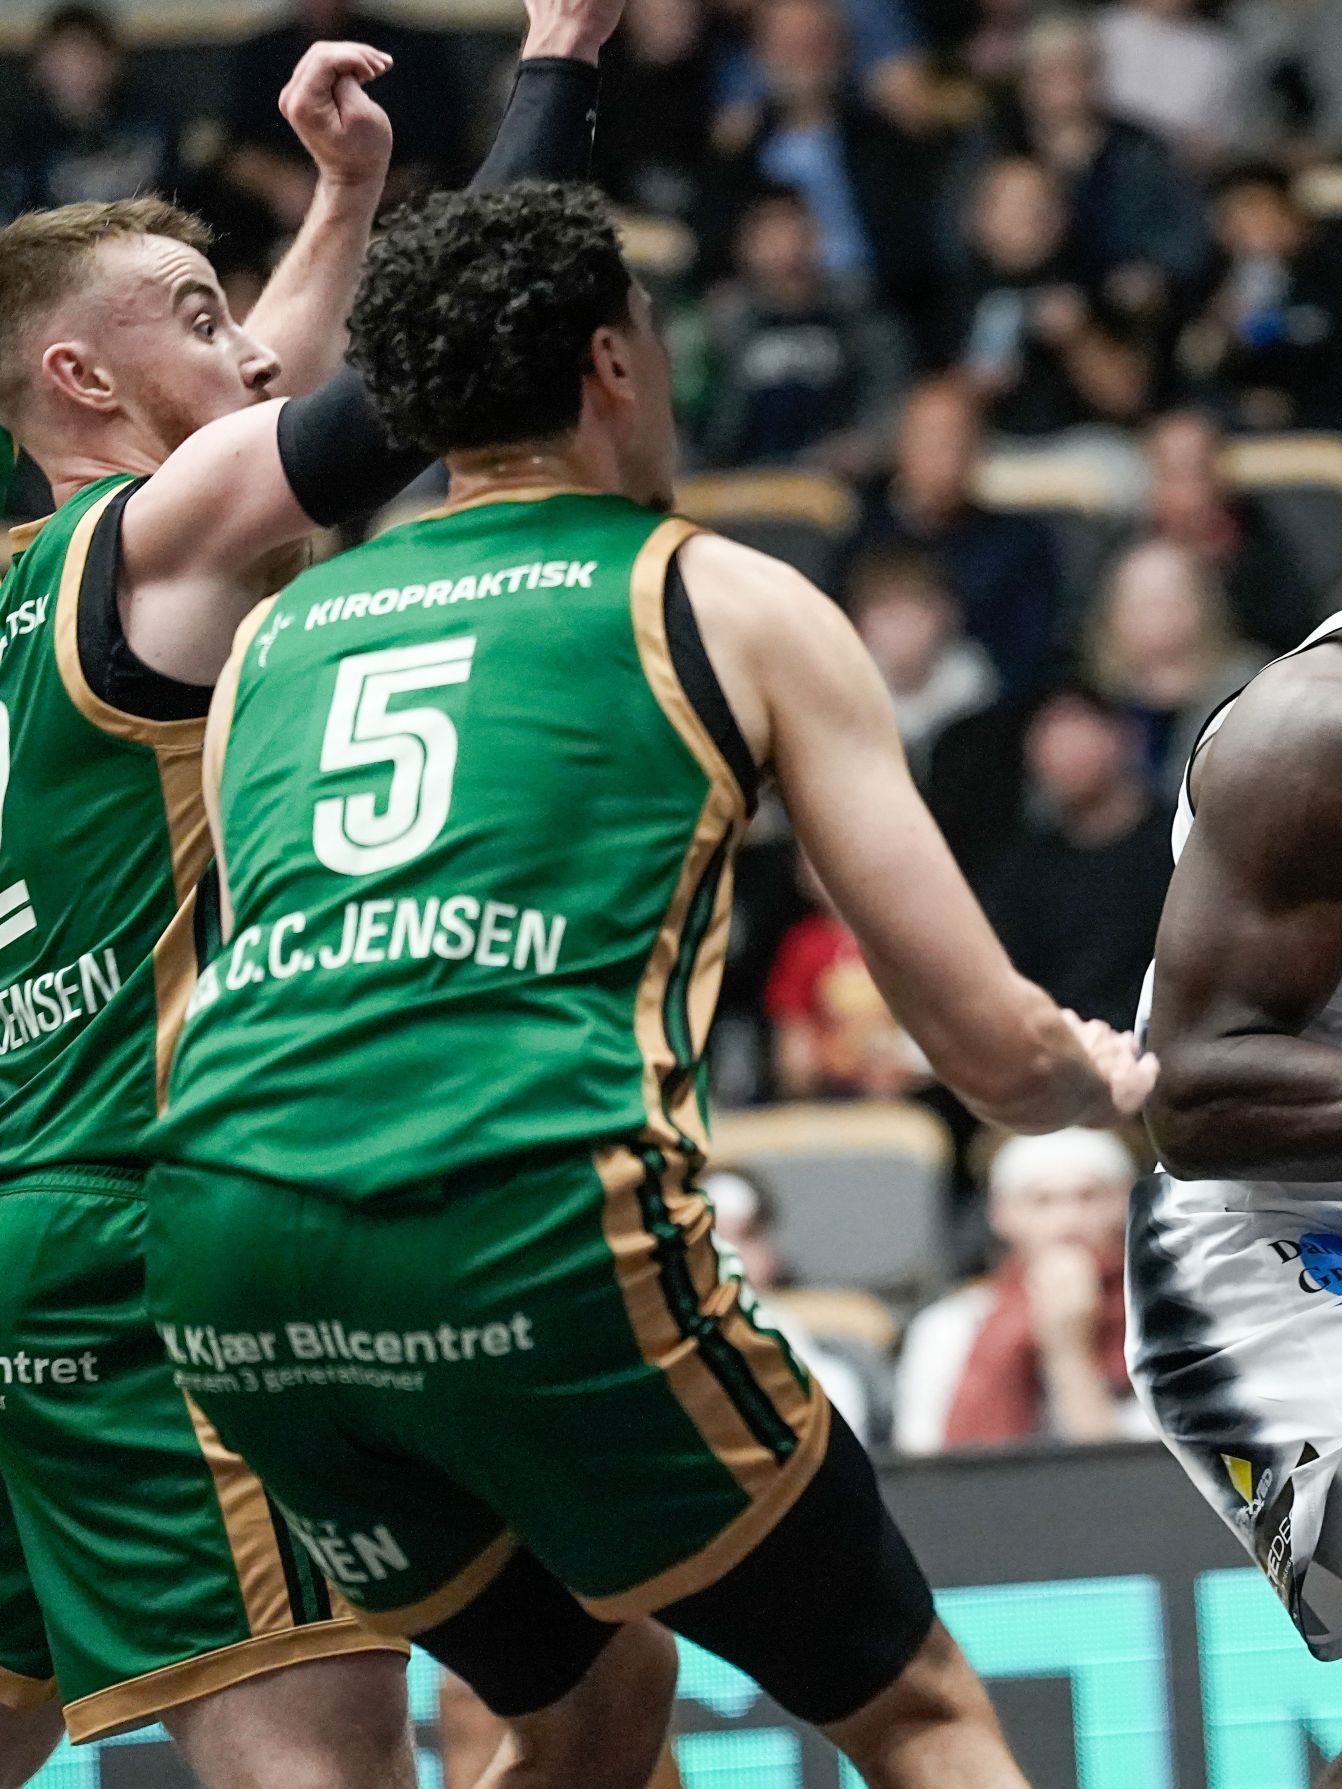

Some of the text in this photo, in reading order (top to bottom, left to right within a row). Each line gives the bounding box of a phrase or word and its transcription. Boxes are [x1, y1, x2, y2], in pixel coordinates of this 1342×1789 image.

[304, 561, 597, 631] KIROPRAKTISK
[313, 636, 477, 876] 5
[286, 1311, 533, 1363] Bilcentret
